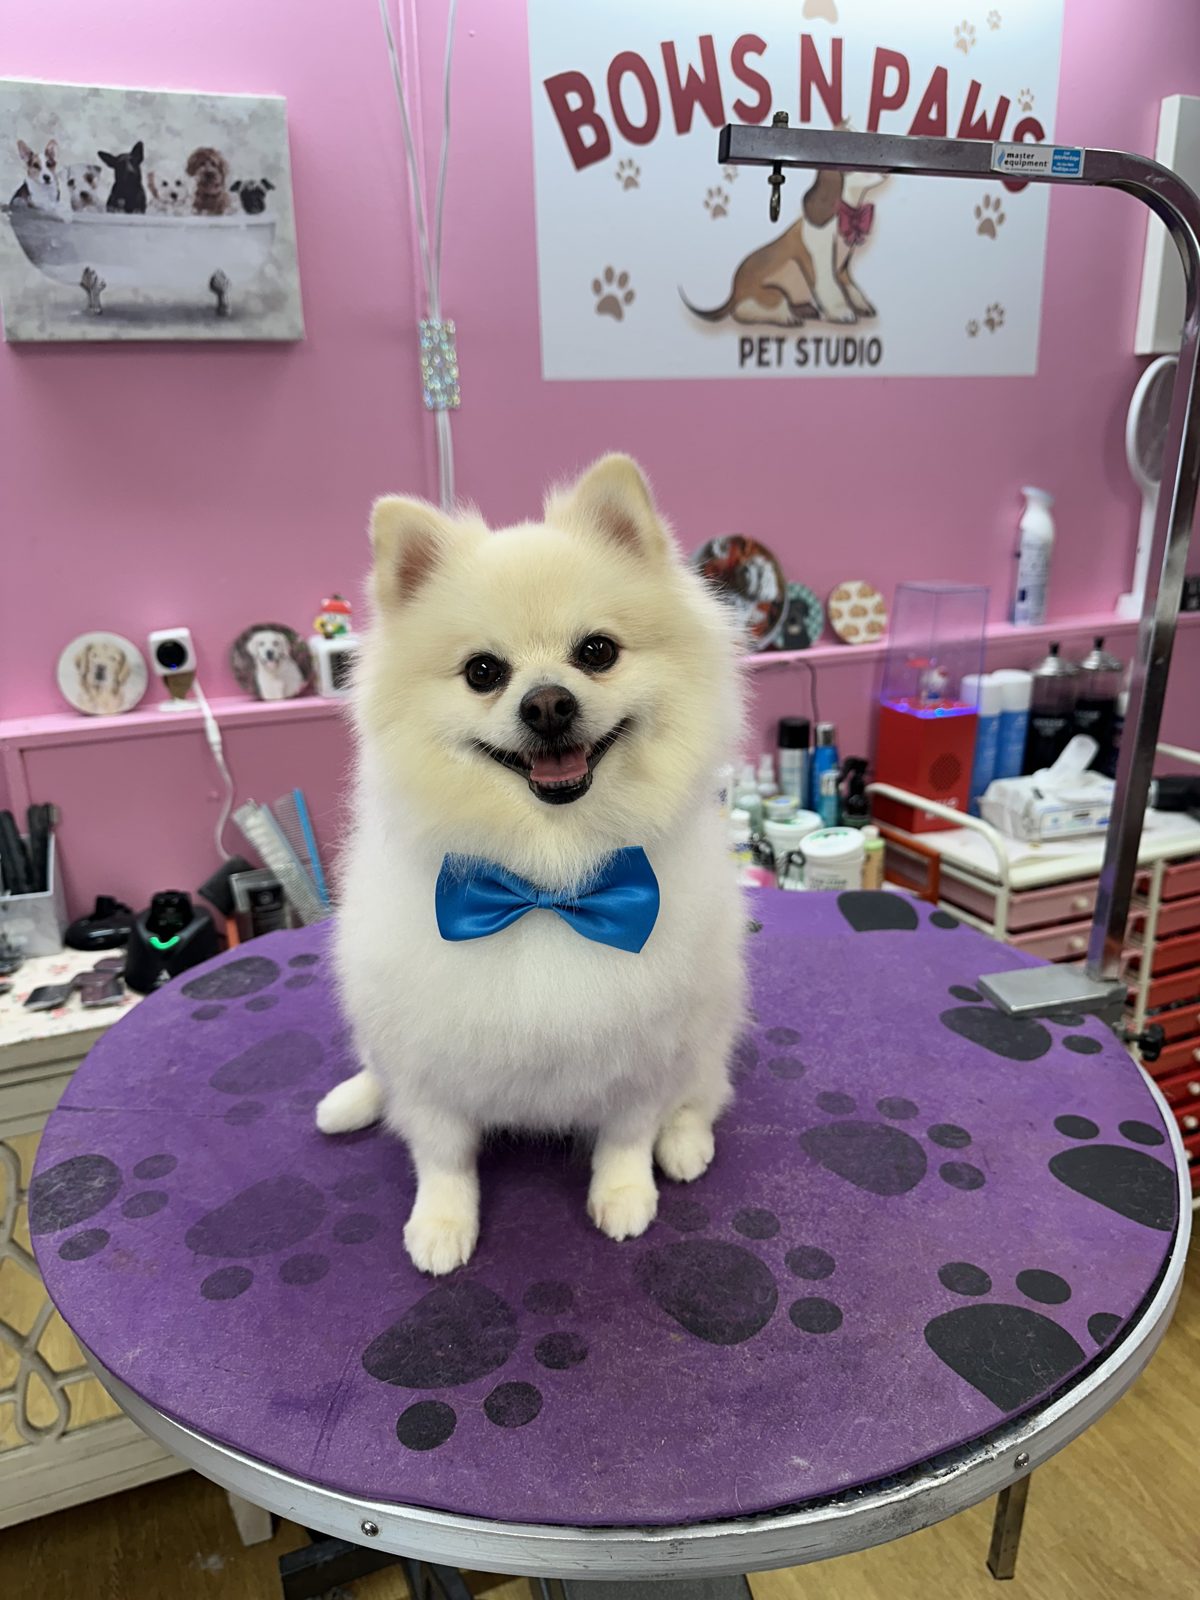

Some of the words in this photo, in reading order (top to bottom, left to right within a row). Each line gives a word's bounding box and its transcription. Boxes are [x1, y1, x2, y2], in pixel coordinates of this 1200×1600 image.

[543, 33, 772, 172] BOWS
[799, 33, 843, 128] N
[1004, 159, 1048, 168] equipment
[1006, 152, 1035, 160] master
[739, 336, 786, 367] PET
[795, 336, 882, 367] STUDIO
